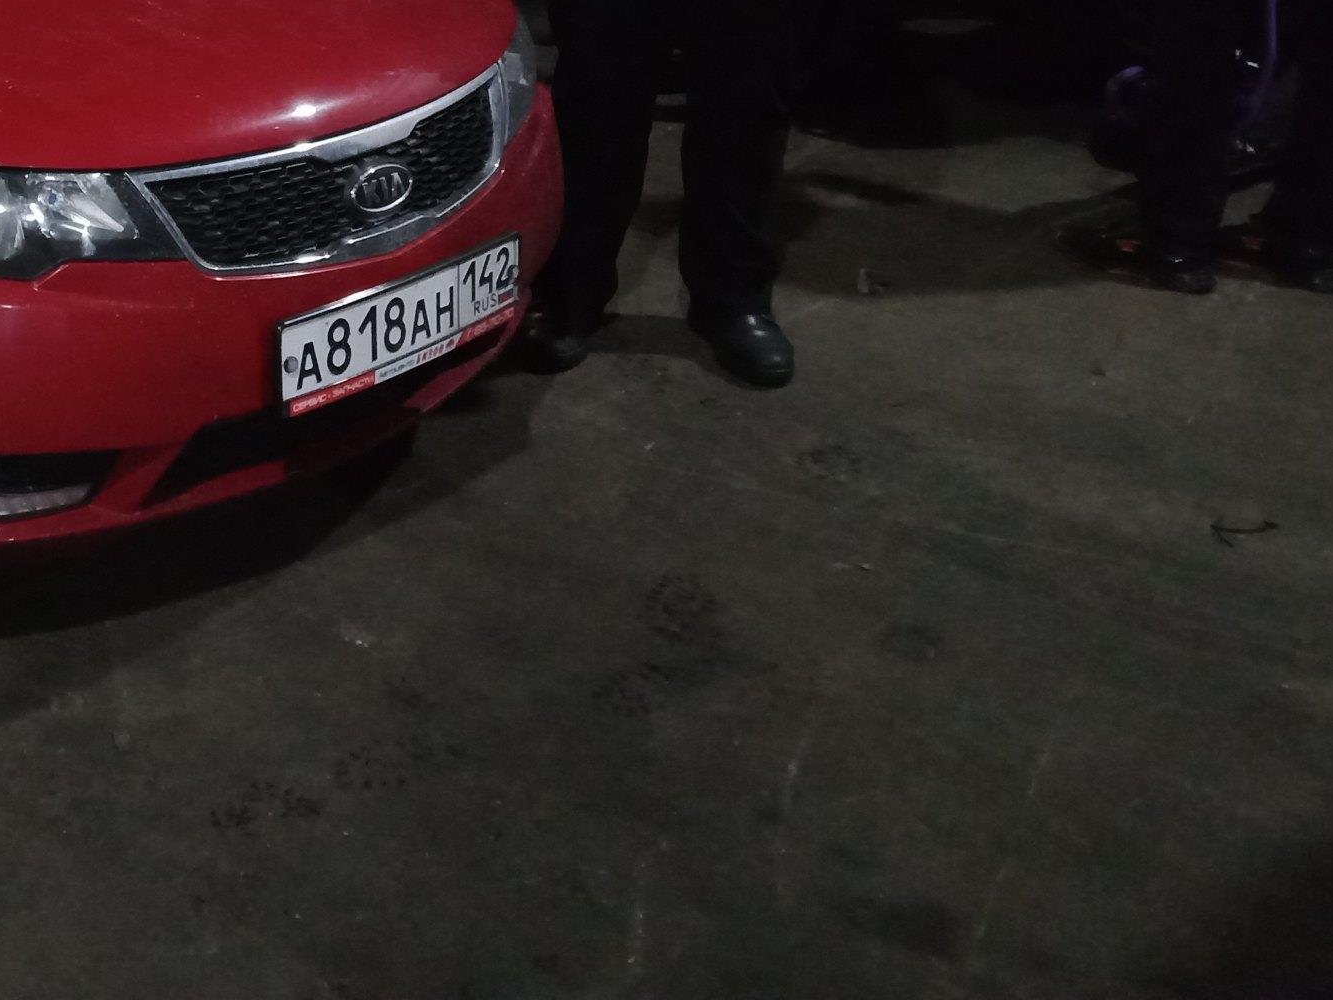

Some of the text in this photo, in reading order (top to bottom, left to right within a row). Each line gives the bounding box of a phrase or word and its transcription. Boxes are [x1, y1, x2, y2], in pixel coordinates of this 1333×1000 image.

[361, 172, 407, 203] KIA
[296, 246, 512, 390] А818АН 142
[473, 292, 498, 316] RUS
